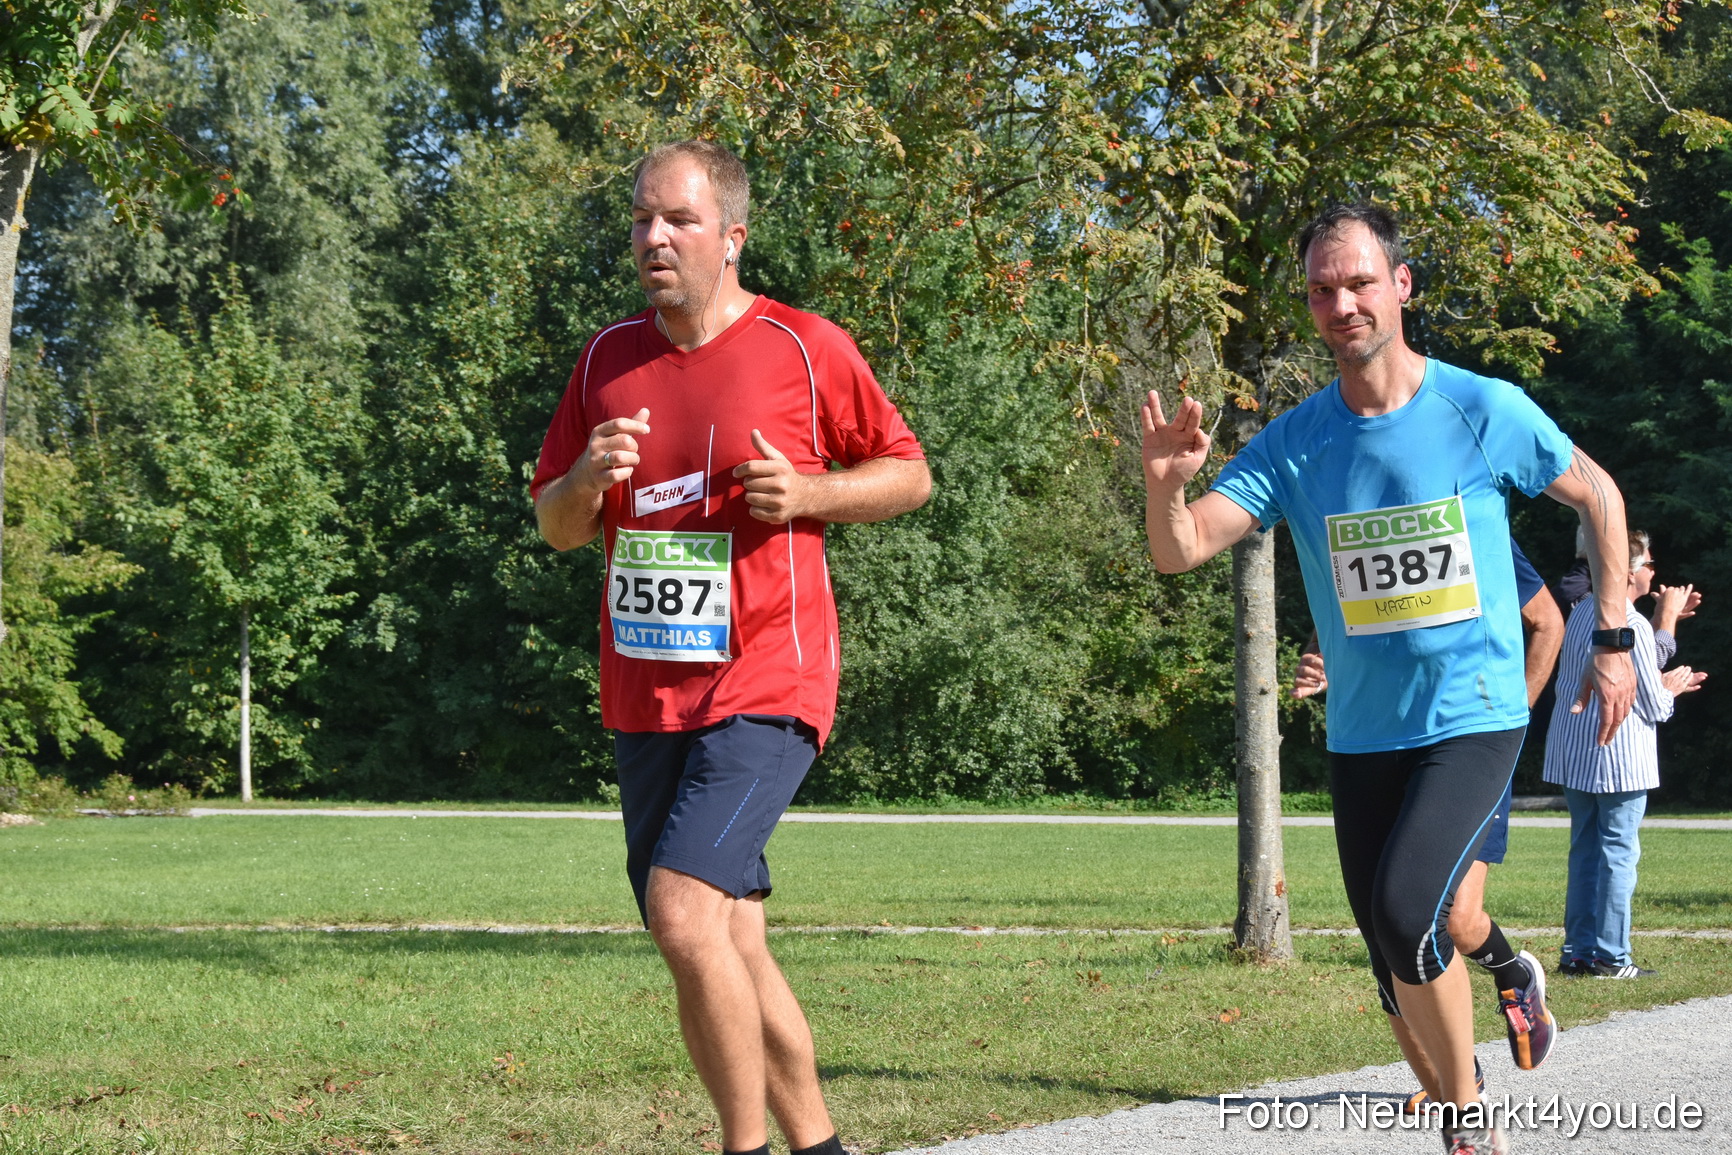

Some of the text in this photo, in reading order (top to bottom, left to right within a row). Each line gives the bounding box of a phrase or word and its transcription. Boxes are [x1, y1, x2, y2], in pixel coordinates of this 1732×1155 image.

[653, 485, 685, 504] DEHN
[1337, 506, 1452, 545] BOCK
[615, 536, 715, 565] BOCK
[1347, 543, 1452, 592] 1387
[615, 575, 711, 616] 2587
[716, 582, 723, 590] C
[1375, 595, 1432, 617] MARTIN
[618, 625, 712, 646] MATTHIAS
